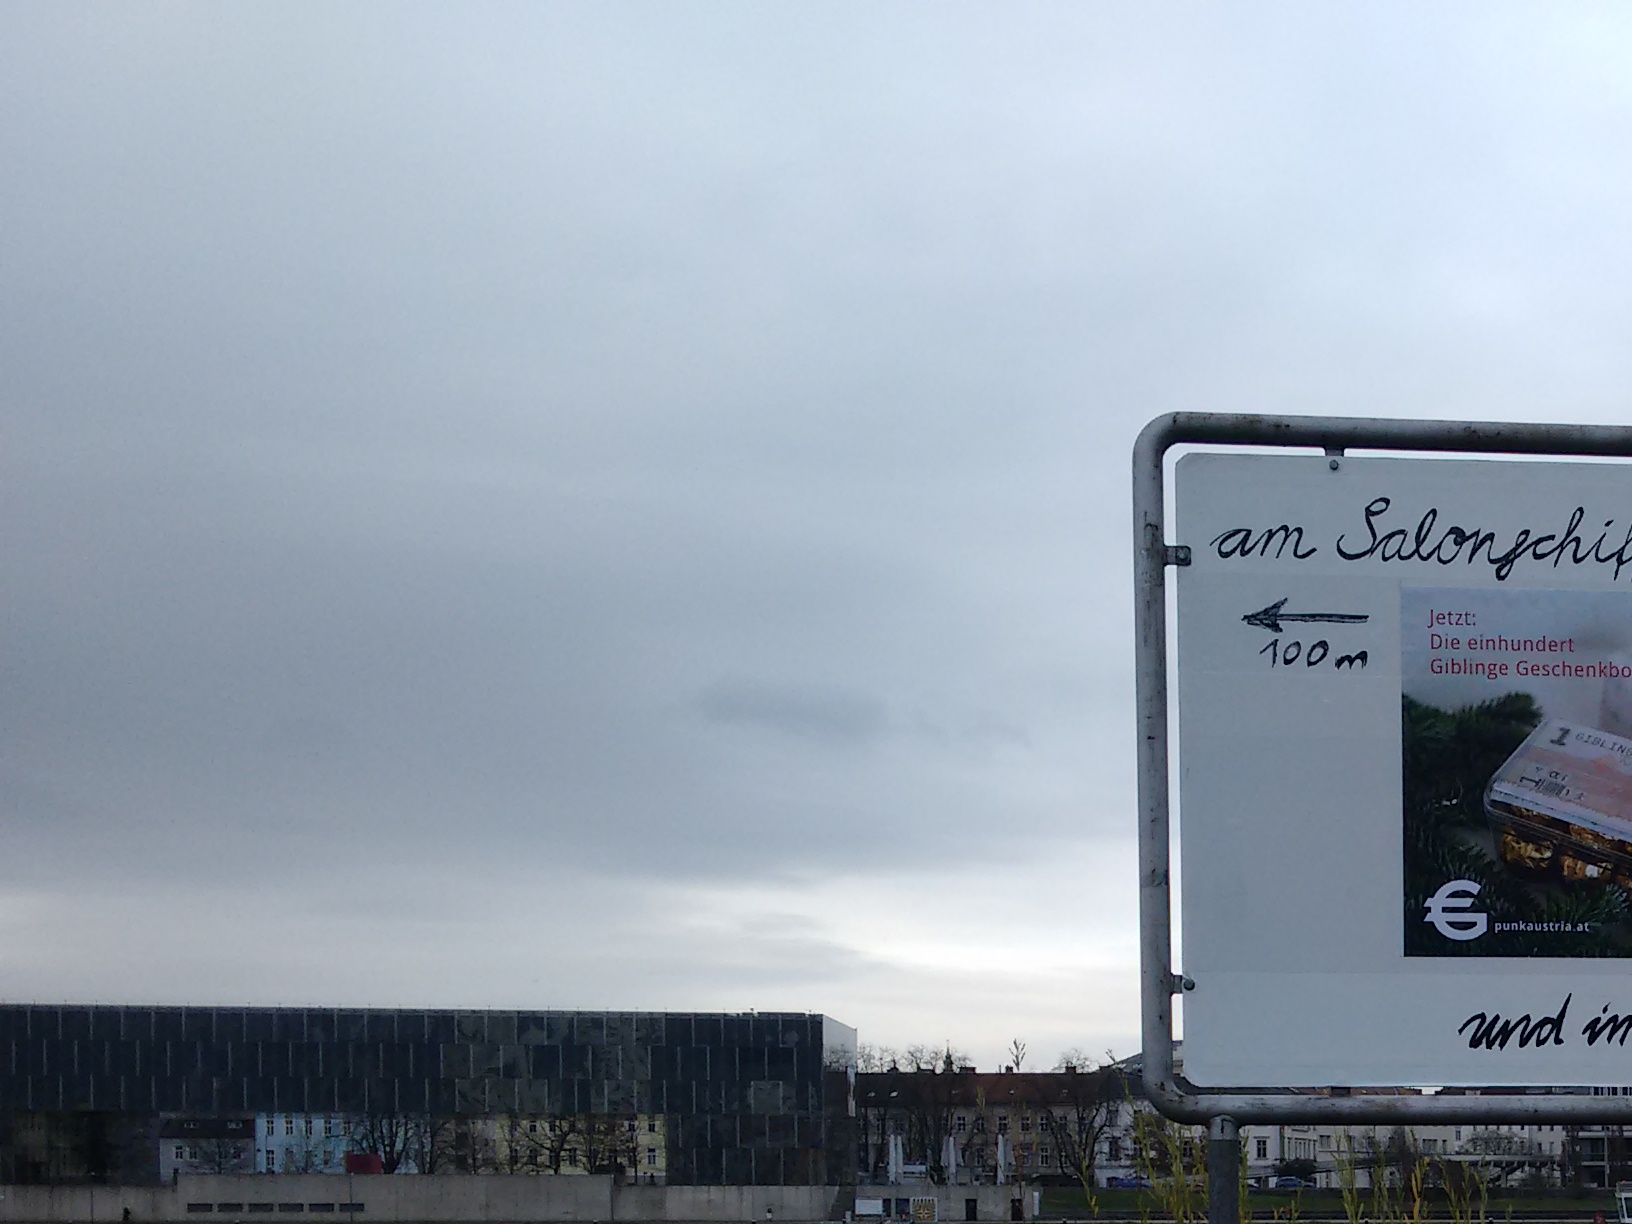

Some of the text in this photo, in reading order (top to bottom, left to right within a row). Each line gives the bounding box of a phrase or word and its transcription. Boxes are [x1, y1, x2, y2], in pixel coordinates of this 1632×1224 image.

[1209, 523, 1318, 560] am
[1427, 609, 1477, 628] Jetzt:
[1430, 633, 1575, 653] Die einhundert
[1430, 658, 1509, 680] Giblinge
[1494, 920, 1590, 934] punkaustria.at
[1457, 992, 1573, 1053] und
